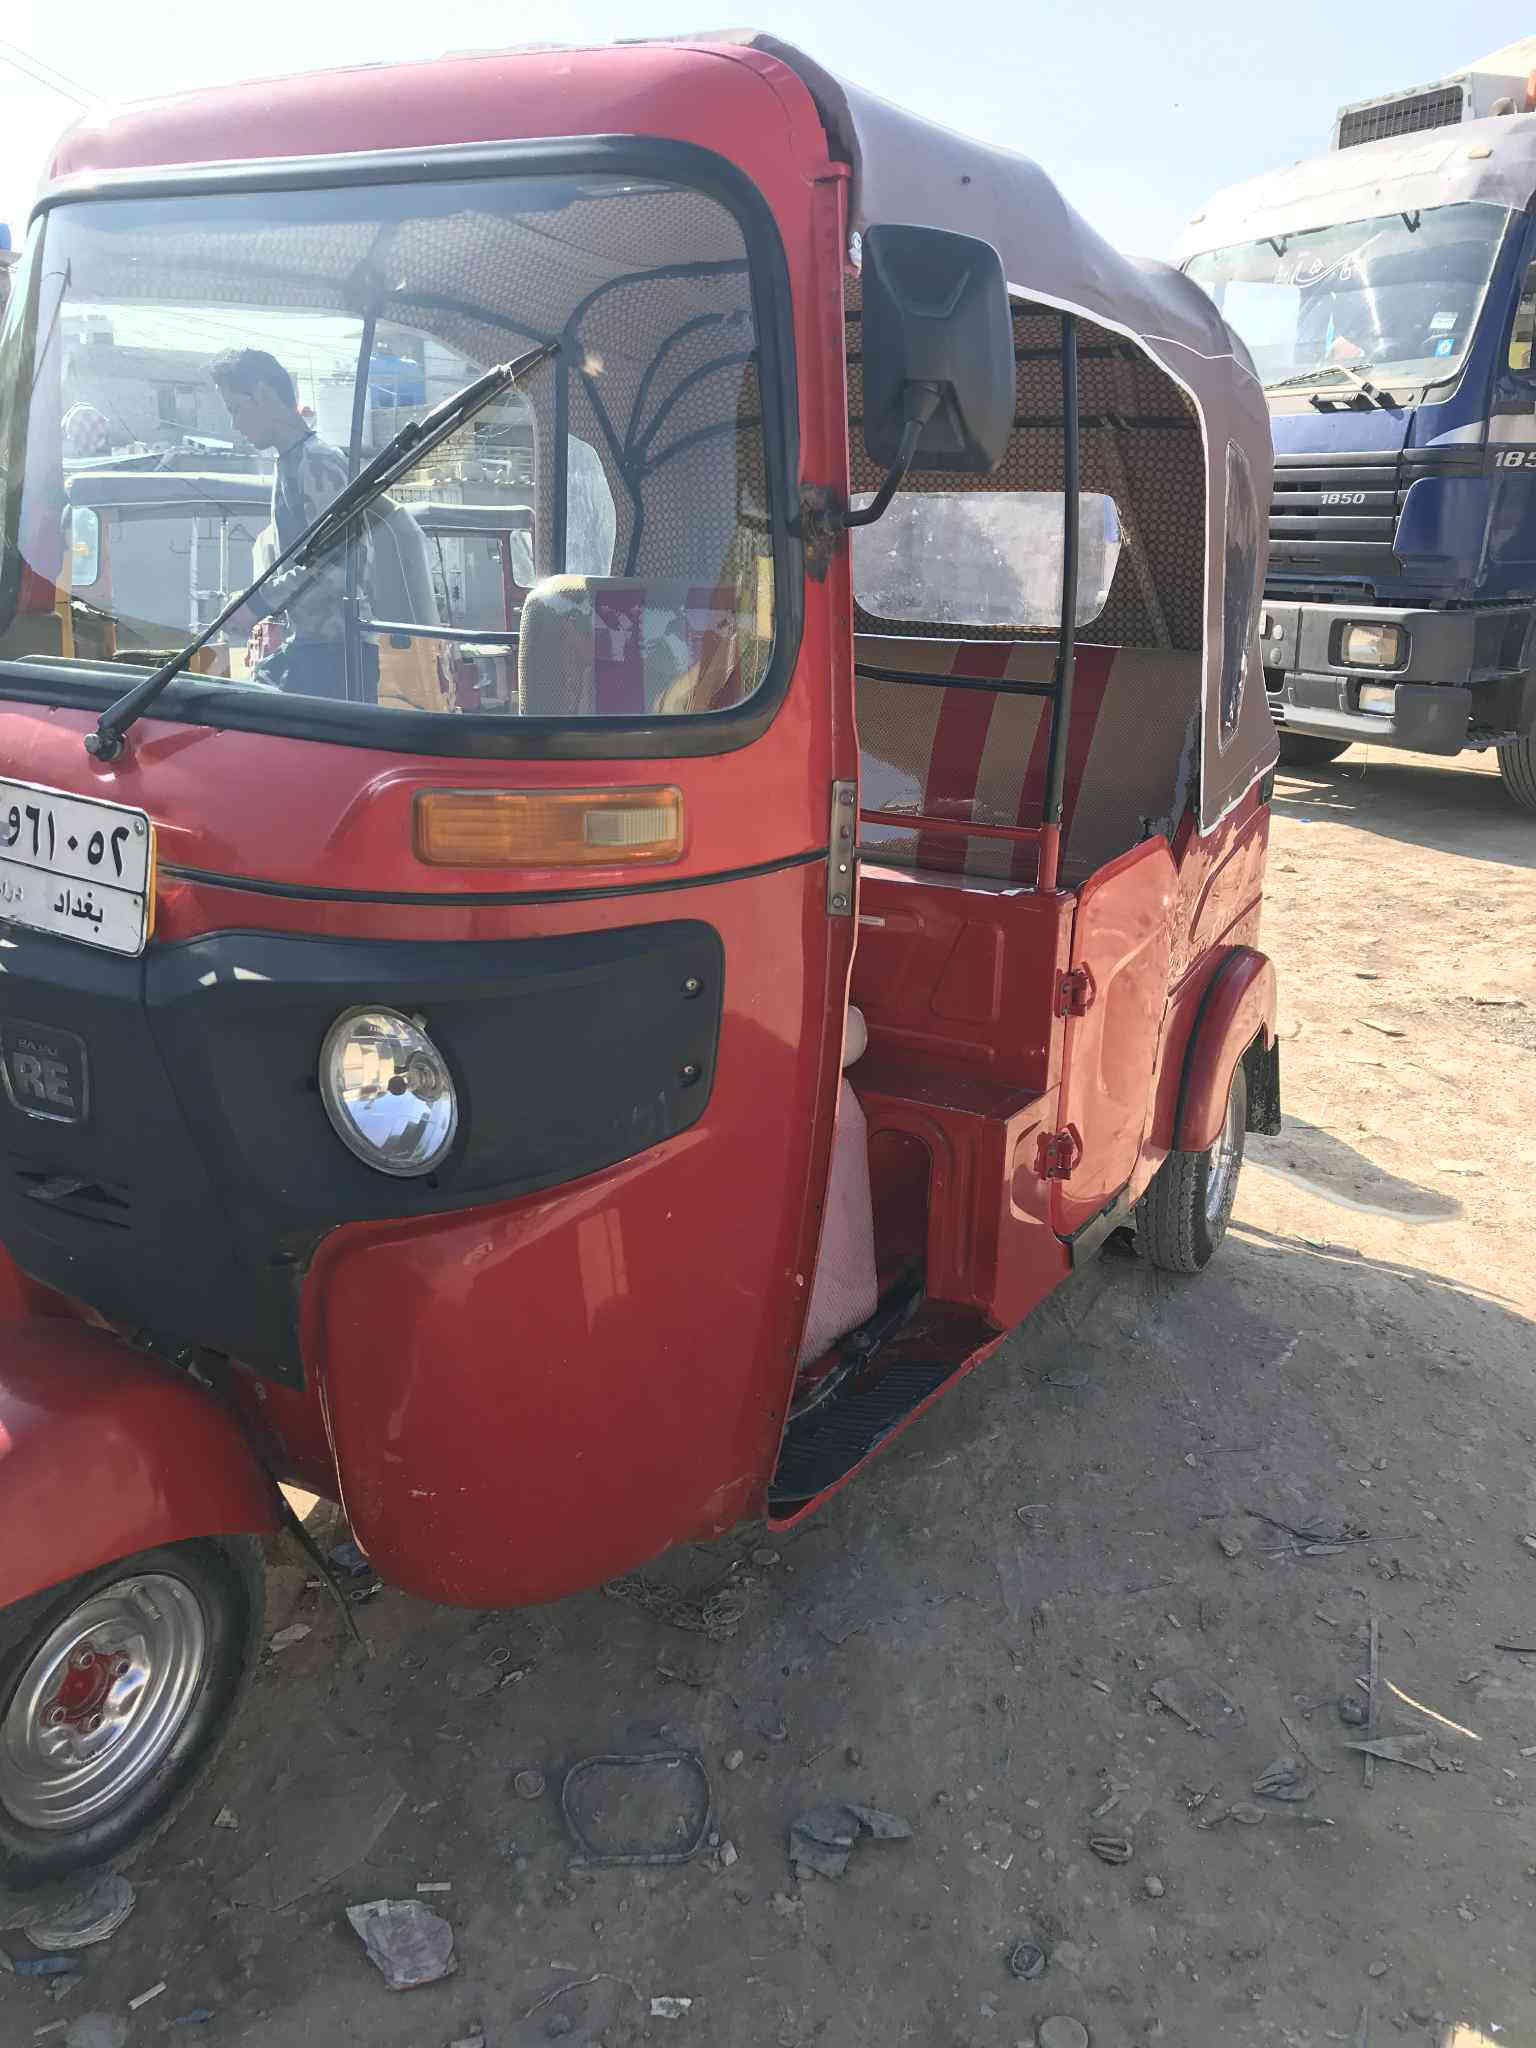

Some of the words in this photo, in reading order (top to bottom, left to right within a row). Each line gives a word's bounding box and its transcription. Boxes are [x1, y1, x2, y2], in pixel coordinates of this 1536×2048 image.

[1320, 493, 1366, 505] 1850
[8, 804, 131, 877] ٩٦١٠٥٢
[54, 889, 103, 933] بغداد
[13, 1052, 74, 1107] RE
